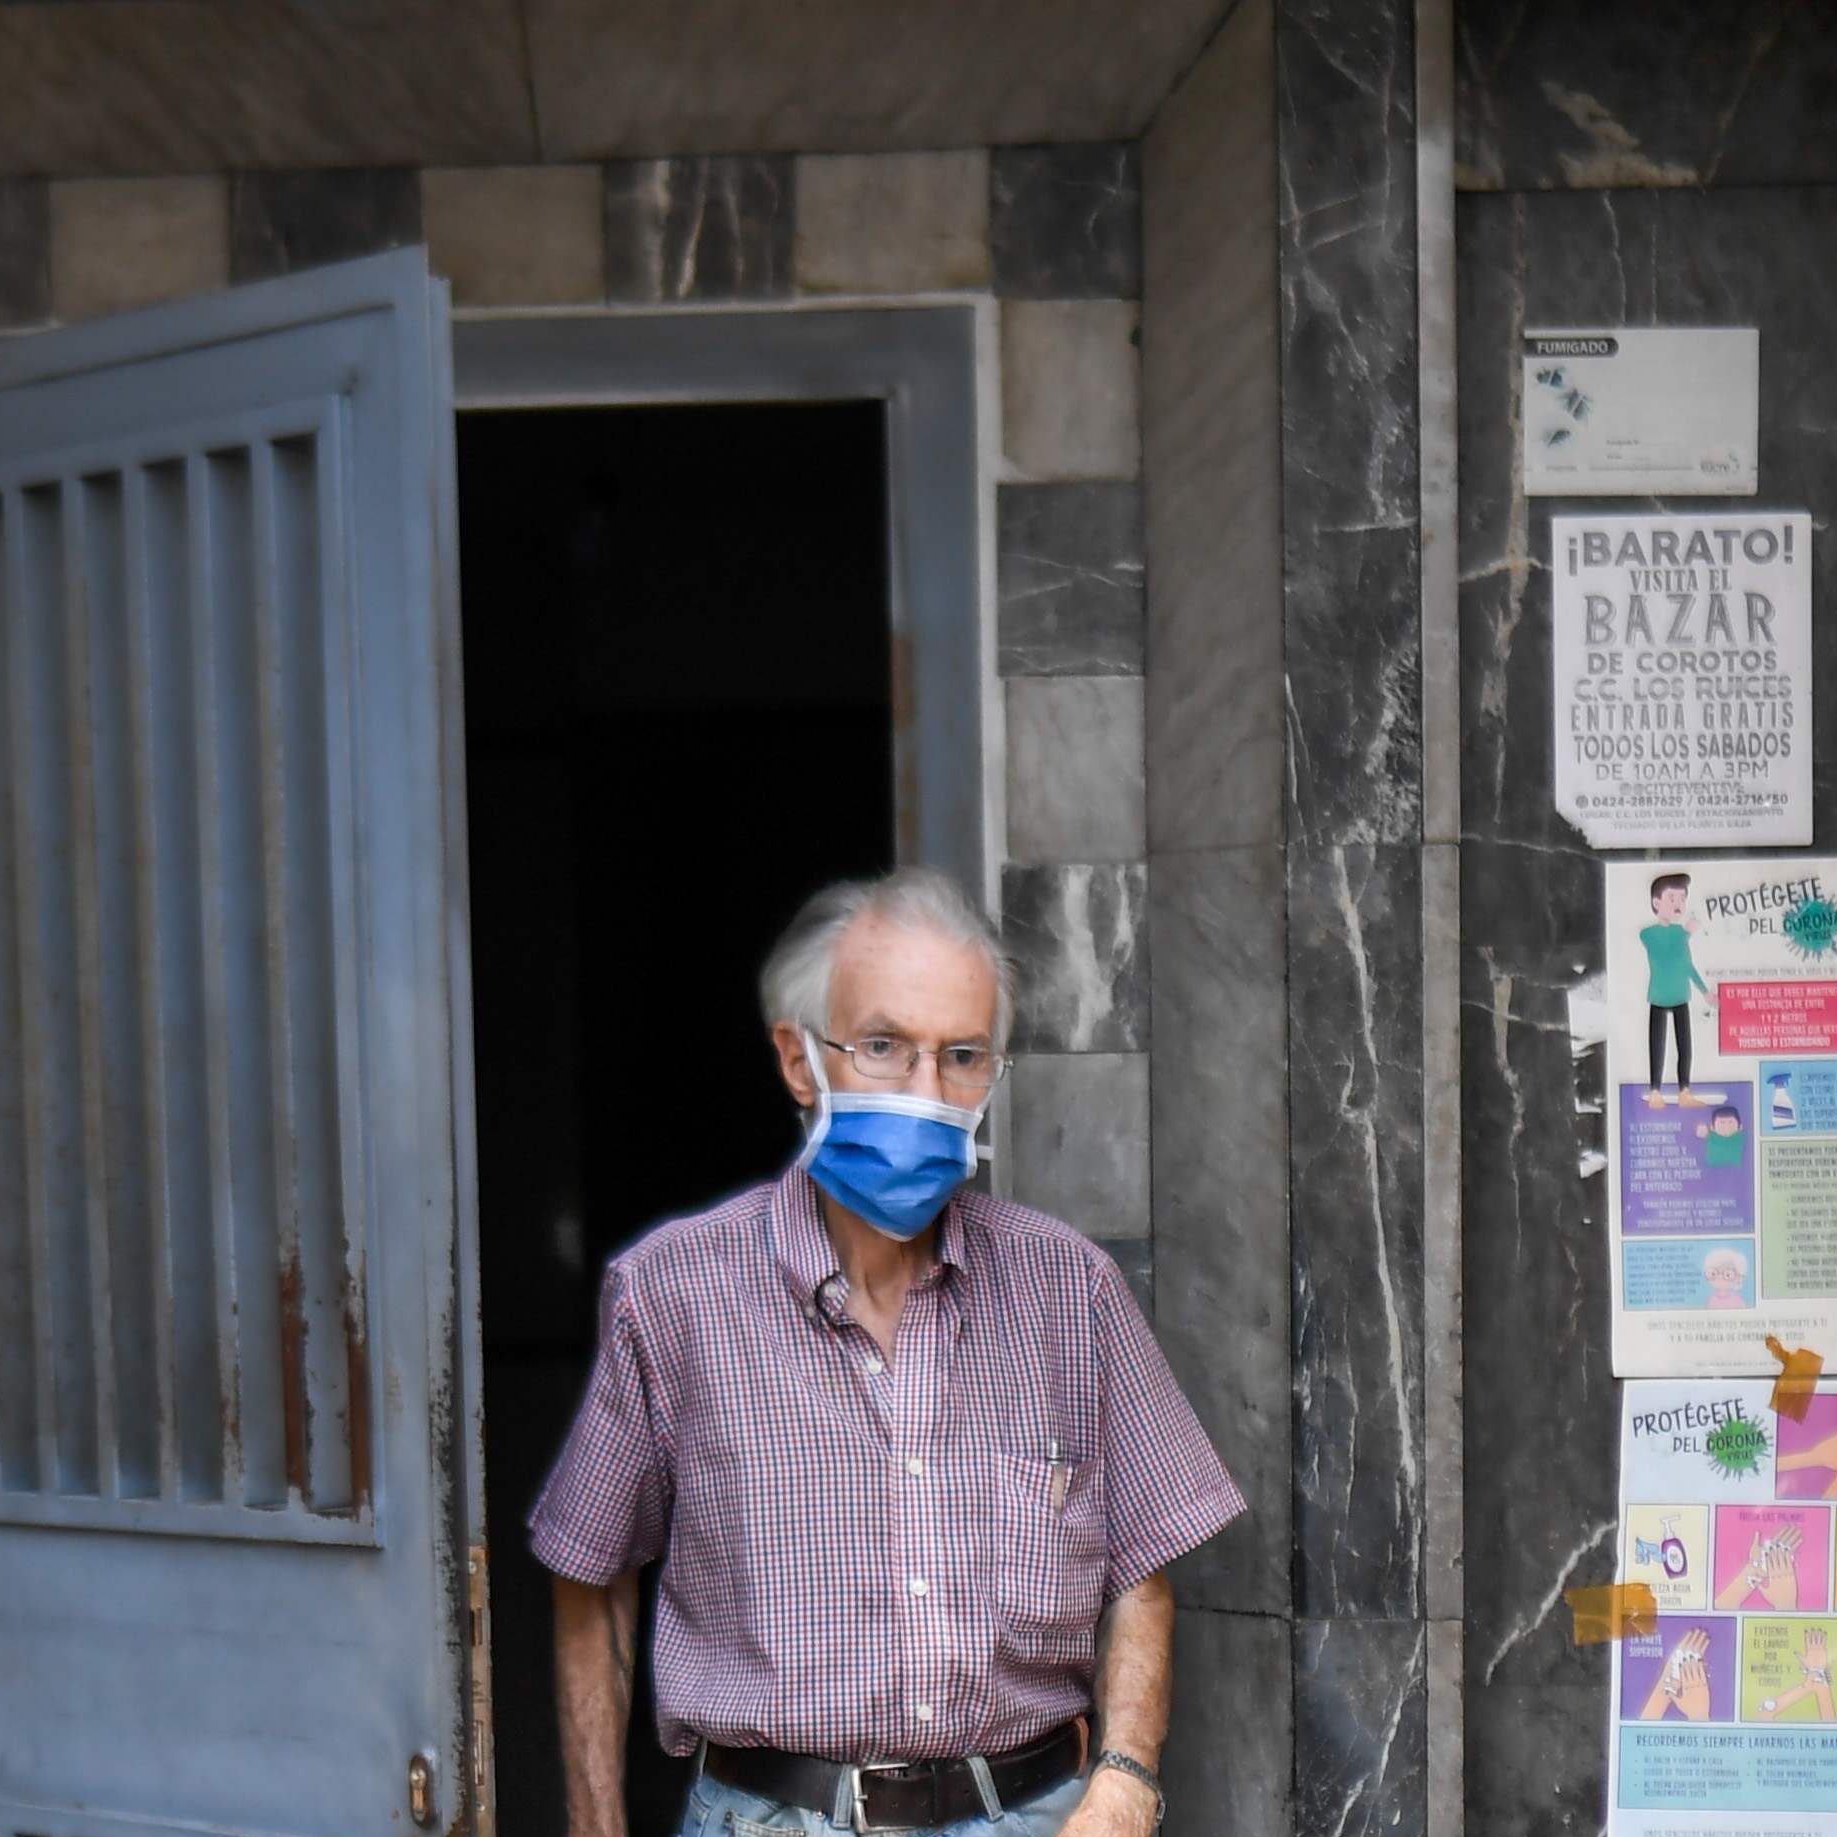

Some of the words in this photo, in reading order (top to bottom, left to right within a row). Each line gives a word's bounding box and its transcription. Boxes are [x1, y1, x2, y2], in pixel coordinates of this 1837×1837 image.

[1537, 341, 1609, 355] FUMIGADO
[1569, 524, 1794, 576] ¡BARATO!
[1630, 568, 1698, 593] VISITA
[1709, 569, 1732, 592] EL
[1584, 591, 1777, 647] BAZAR
[1587, 652, 1623, 676] DE
[1636, 649, 1778, 674] COROTOS
[1574, 678, 1624, 703] C.C.
[1633, 678, 1685, 702] LOS
[1695, 676, 1793, 700] RUICES
[1571, 703, 1686, 732] ENTRADA
[1703, 700, 1795, 730] GRATIS
[1574, 736, 1644, 765] TODOS
[1651, 732, 1690, 762] LOS
[1697, 732, 1793, 761] SABADOS
[1595, 762, 1624, 782] DE
[1634, 760, 1691, 782] 10AM
[1700, 760, 1716, 781] A
[1724, 757, 1770, 780] 3PM
[1706, 877, 1824, 920] PROTÉGETE
[1749, 917, 1780, 935] DEL
[1633, 1398, 1748, 1438] PROTÉGETE
[1673, 1436, 1702, 1453] DEL
[1706, 1430, 1768, 1453] CORONA
[1636, 1735, 1699, 1748] RECORDEMOS
[1703, 1735, 1745, 1749] SIEMPRE
[1748, 1736, 1796, 1750] LAVARNOS
[1799, 1737, 1817, 1750] LAS
